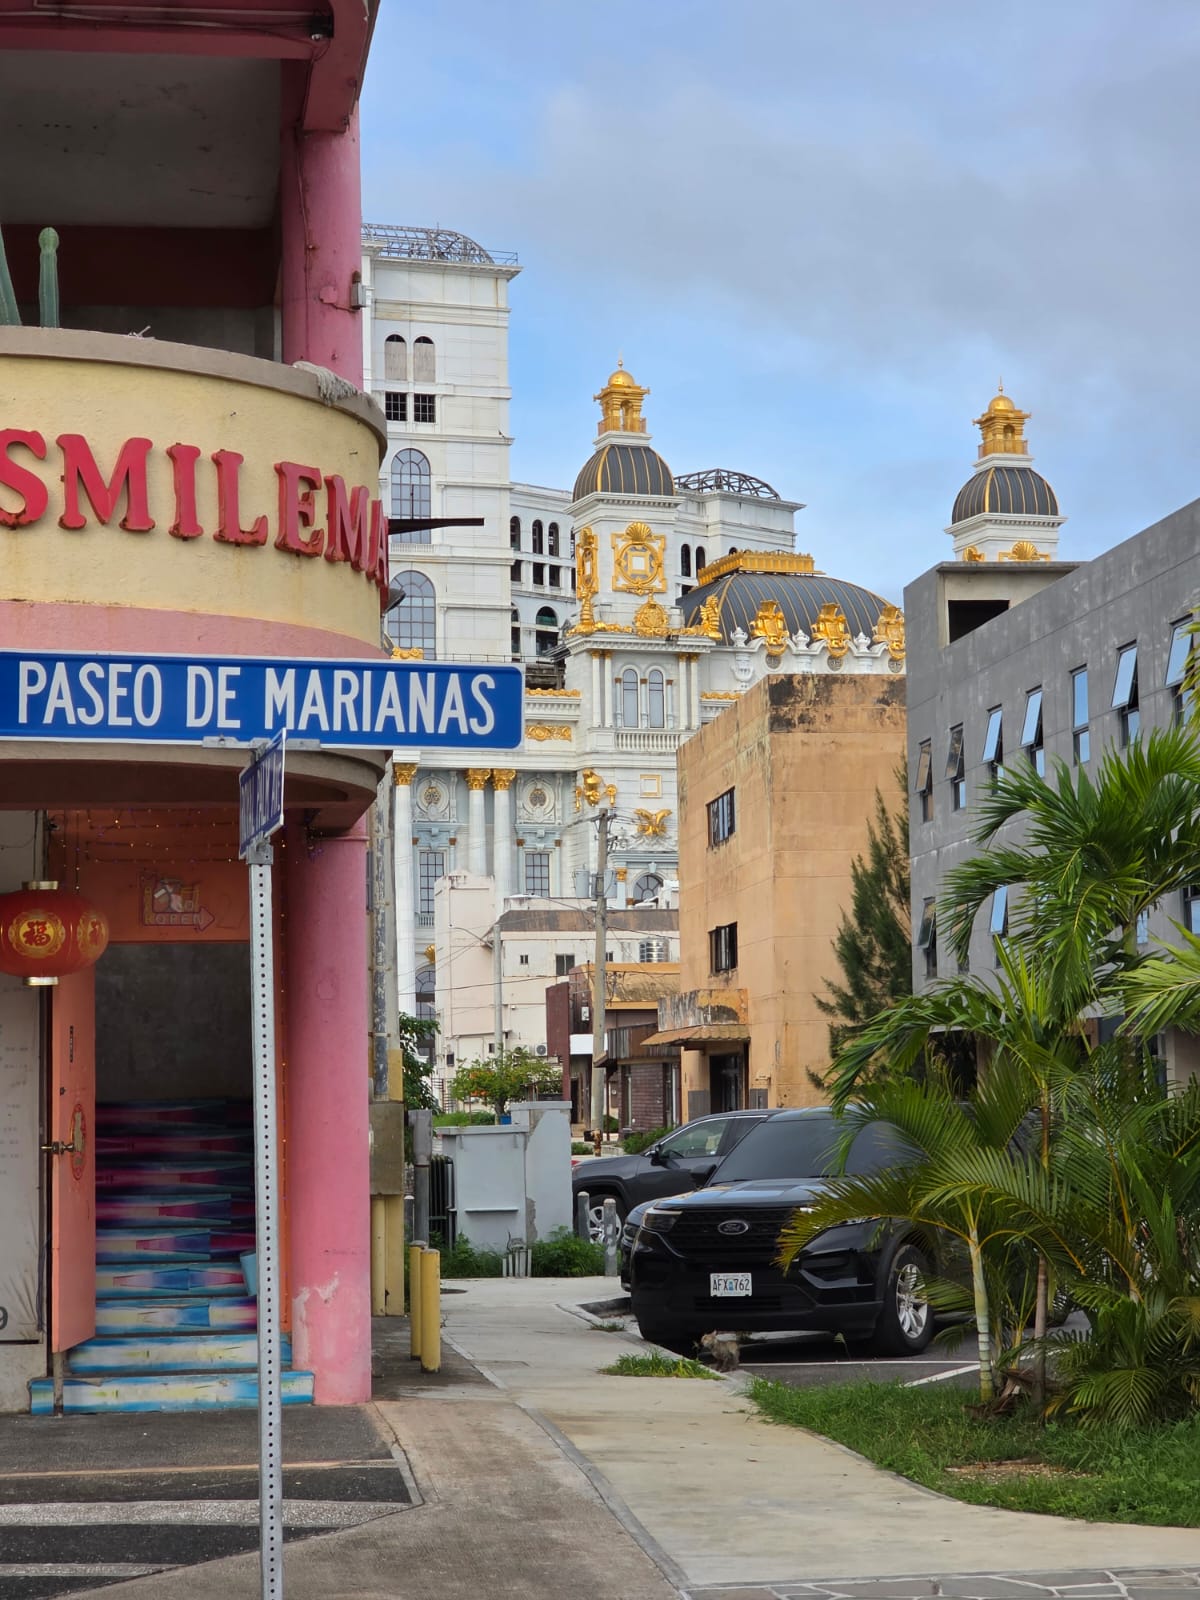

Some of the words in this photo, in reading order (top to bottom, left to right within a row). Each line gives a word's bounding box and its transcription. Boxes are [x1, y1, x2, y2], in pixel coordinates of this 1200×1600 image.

[18, 661, 162, 727] PASEO
[186, 665, 241, 728] DE
[264, 668, 496, 735] MARIANAS
[155, 913, 203, 925] OPEN
[22, 920, 51, 947] 福
[712, 1278, 729, 1291] AFX
[733, 1278, 750, 1291] 762
